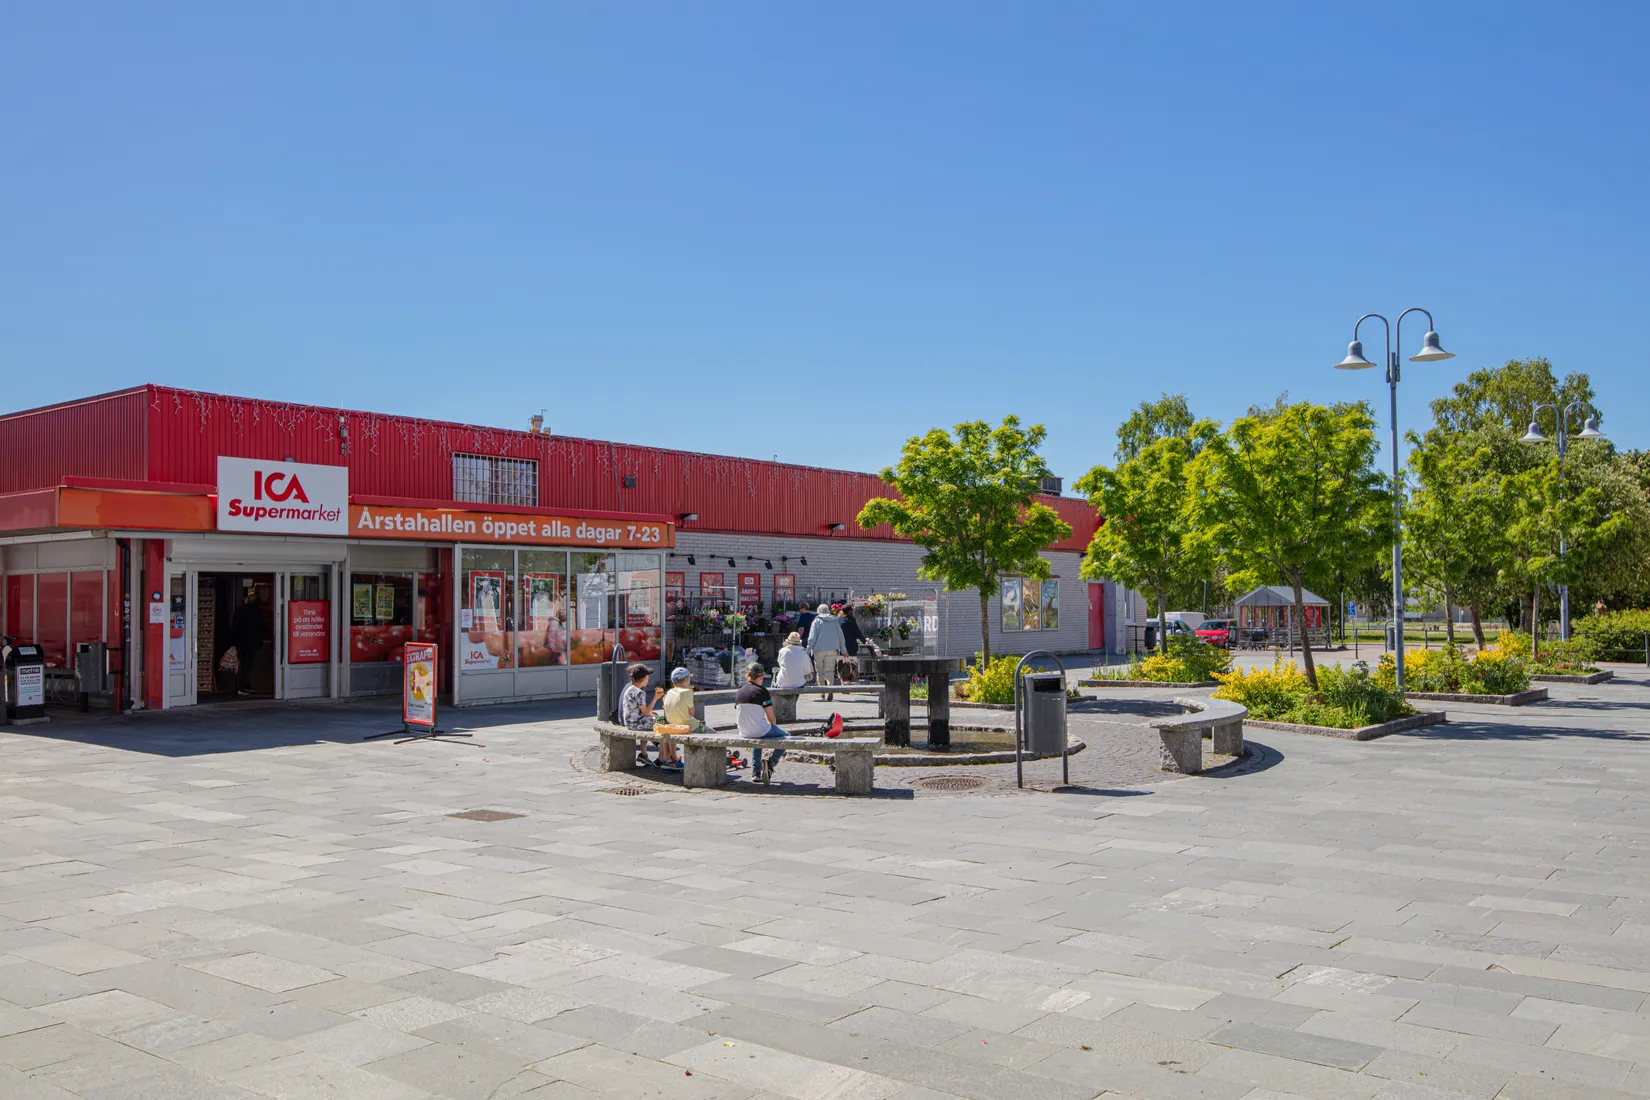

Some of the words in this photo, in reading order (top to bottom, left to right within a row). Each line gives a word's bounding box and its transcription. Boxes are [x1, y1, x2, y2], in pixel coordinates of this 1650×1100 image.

[254, 471, 310, 503] ICA
[228, 499, 341, 521] Supermarket
[357, 506, 476, 534] Årstahallen
[482, 516, 536, 539] öppet
[541, 520, 571, 538] alla
[576, 522, 621, 543] dagar
[627, 525, 660, 542] 7-23
[470, 651, 484, 659] ICA
